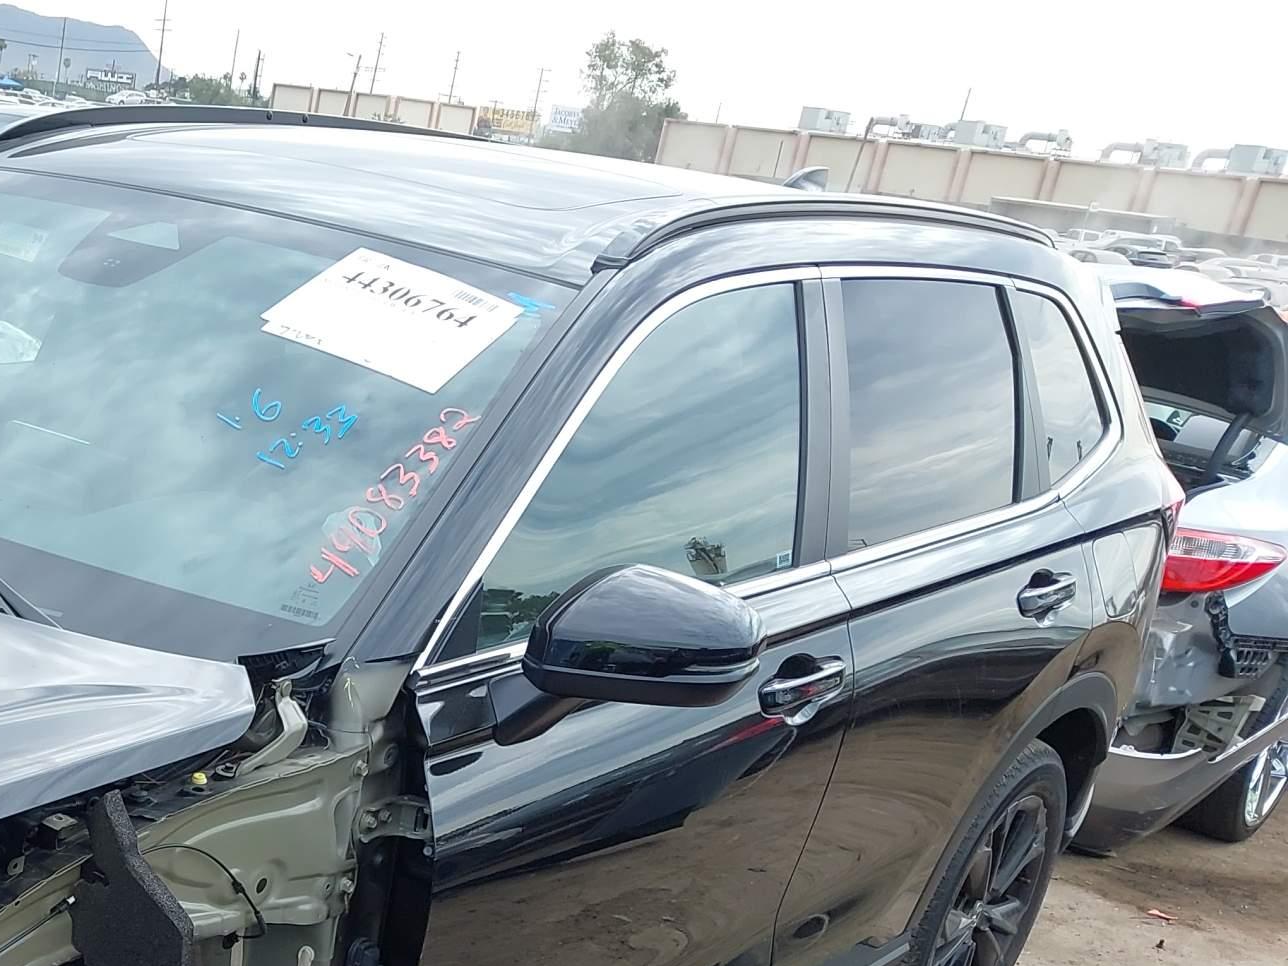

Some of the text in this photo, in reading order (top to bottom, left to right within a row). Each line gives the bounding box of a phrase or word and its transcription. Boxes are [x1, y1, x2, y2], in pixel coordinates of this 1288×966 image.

[341, 271, 478, 328] 44306764
[255, 404, 358, 470] 12:33
[309, 407, 482, 583] 49083382
